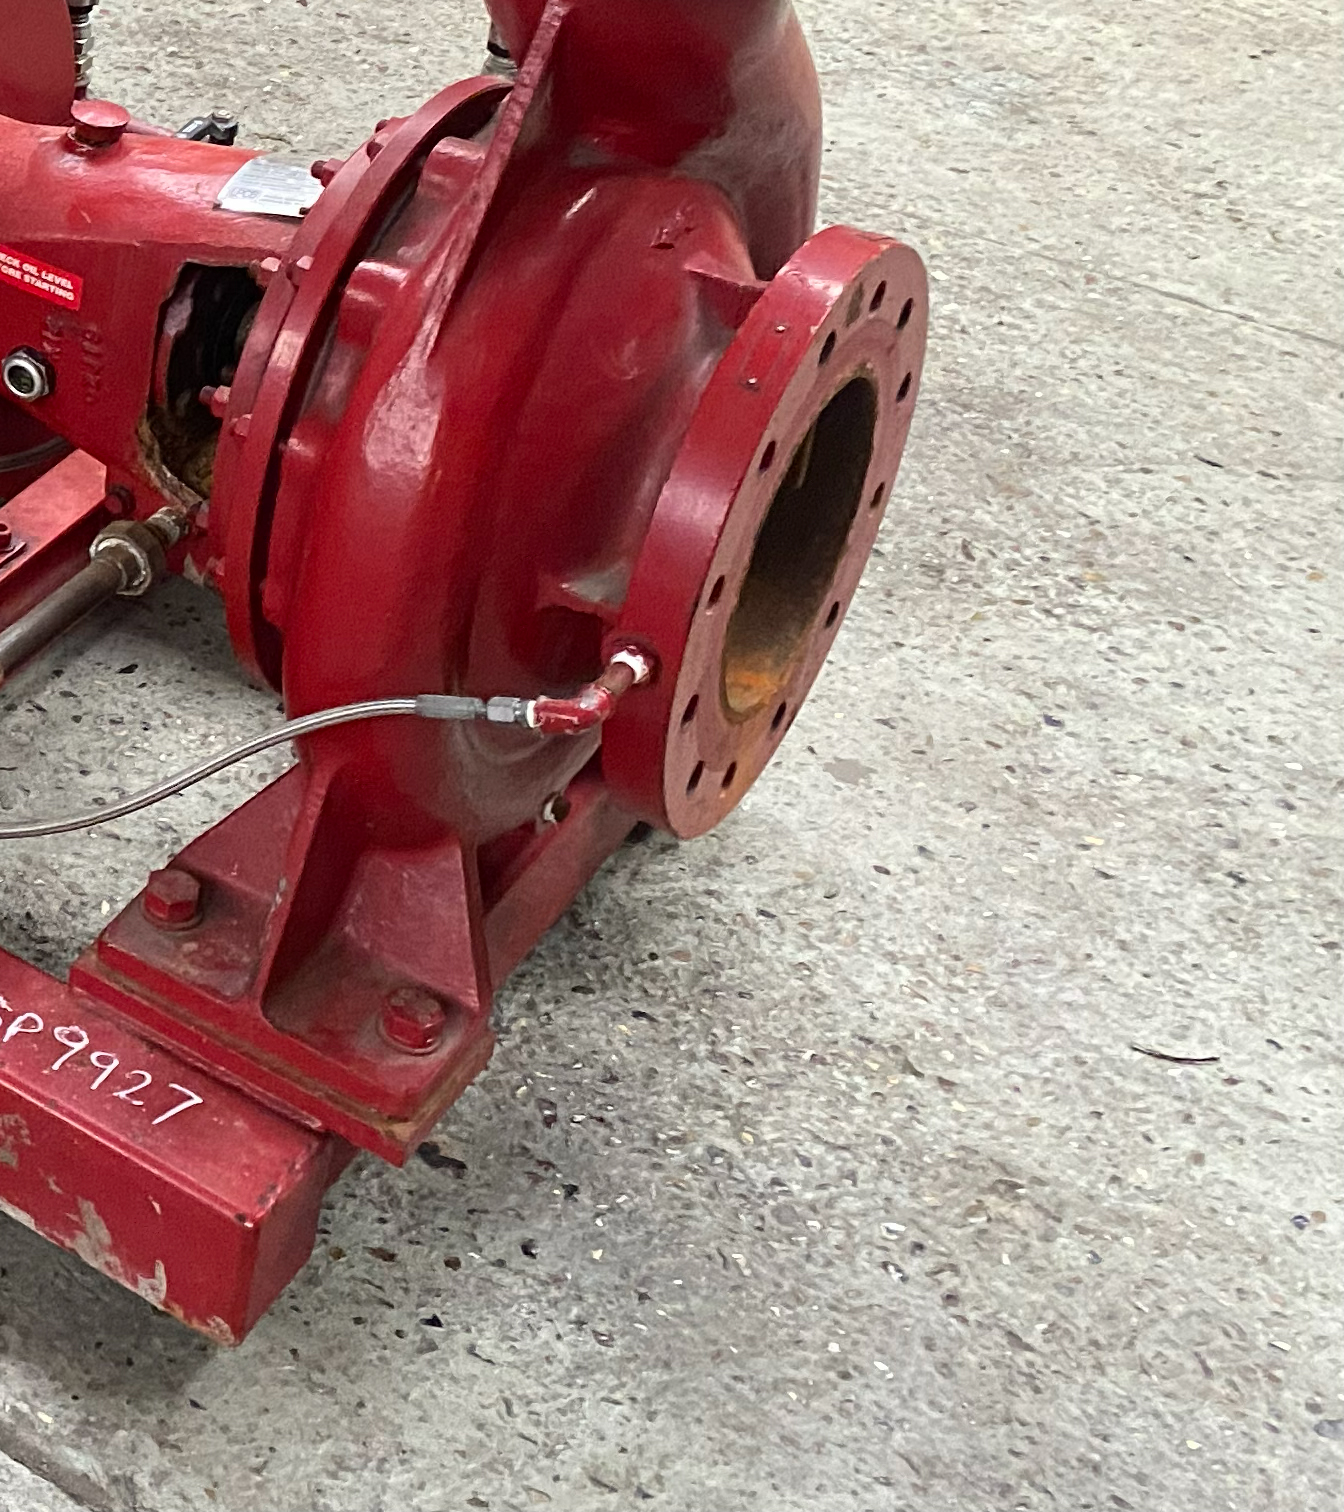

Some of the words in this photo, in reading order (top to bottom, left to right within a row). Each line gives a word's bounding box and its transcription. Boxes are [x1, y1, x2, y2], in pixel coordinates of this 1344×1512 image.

[22, 262, 40, 277] OIL
[40, 270, 74, 290] LEVEL
[22, 274, 75, 301] STARTING
